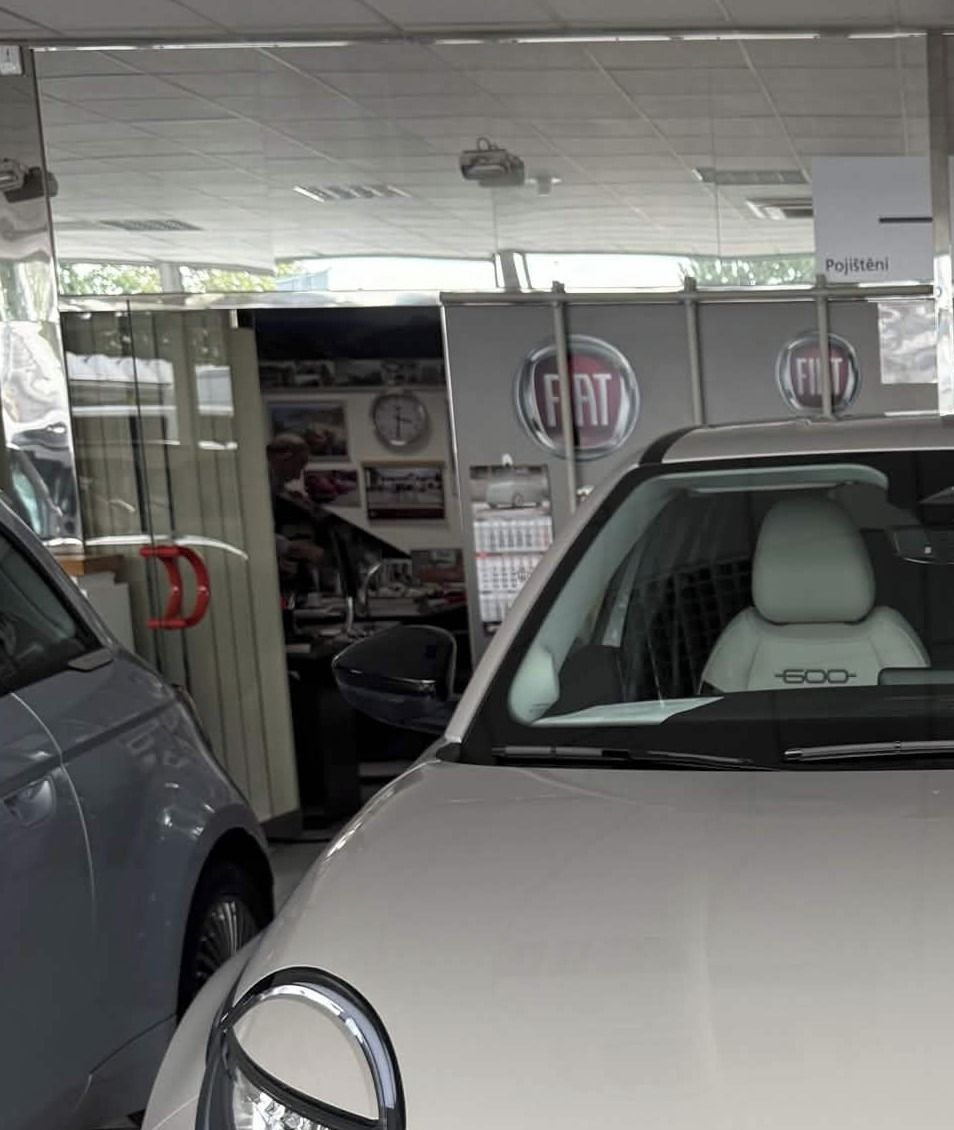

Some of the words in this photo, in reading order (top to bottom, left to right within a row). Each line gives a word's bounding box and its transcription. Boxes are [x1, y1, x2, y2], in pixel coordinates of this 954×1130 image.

[825, 257, 889, 275] Pojištění
[544, 373, 612, 427] FAT
[783, 668, 849, 684] 600
